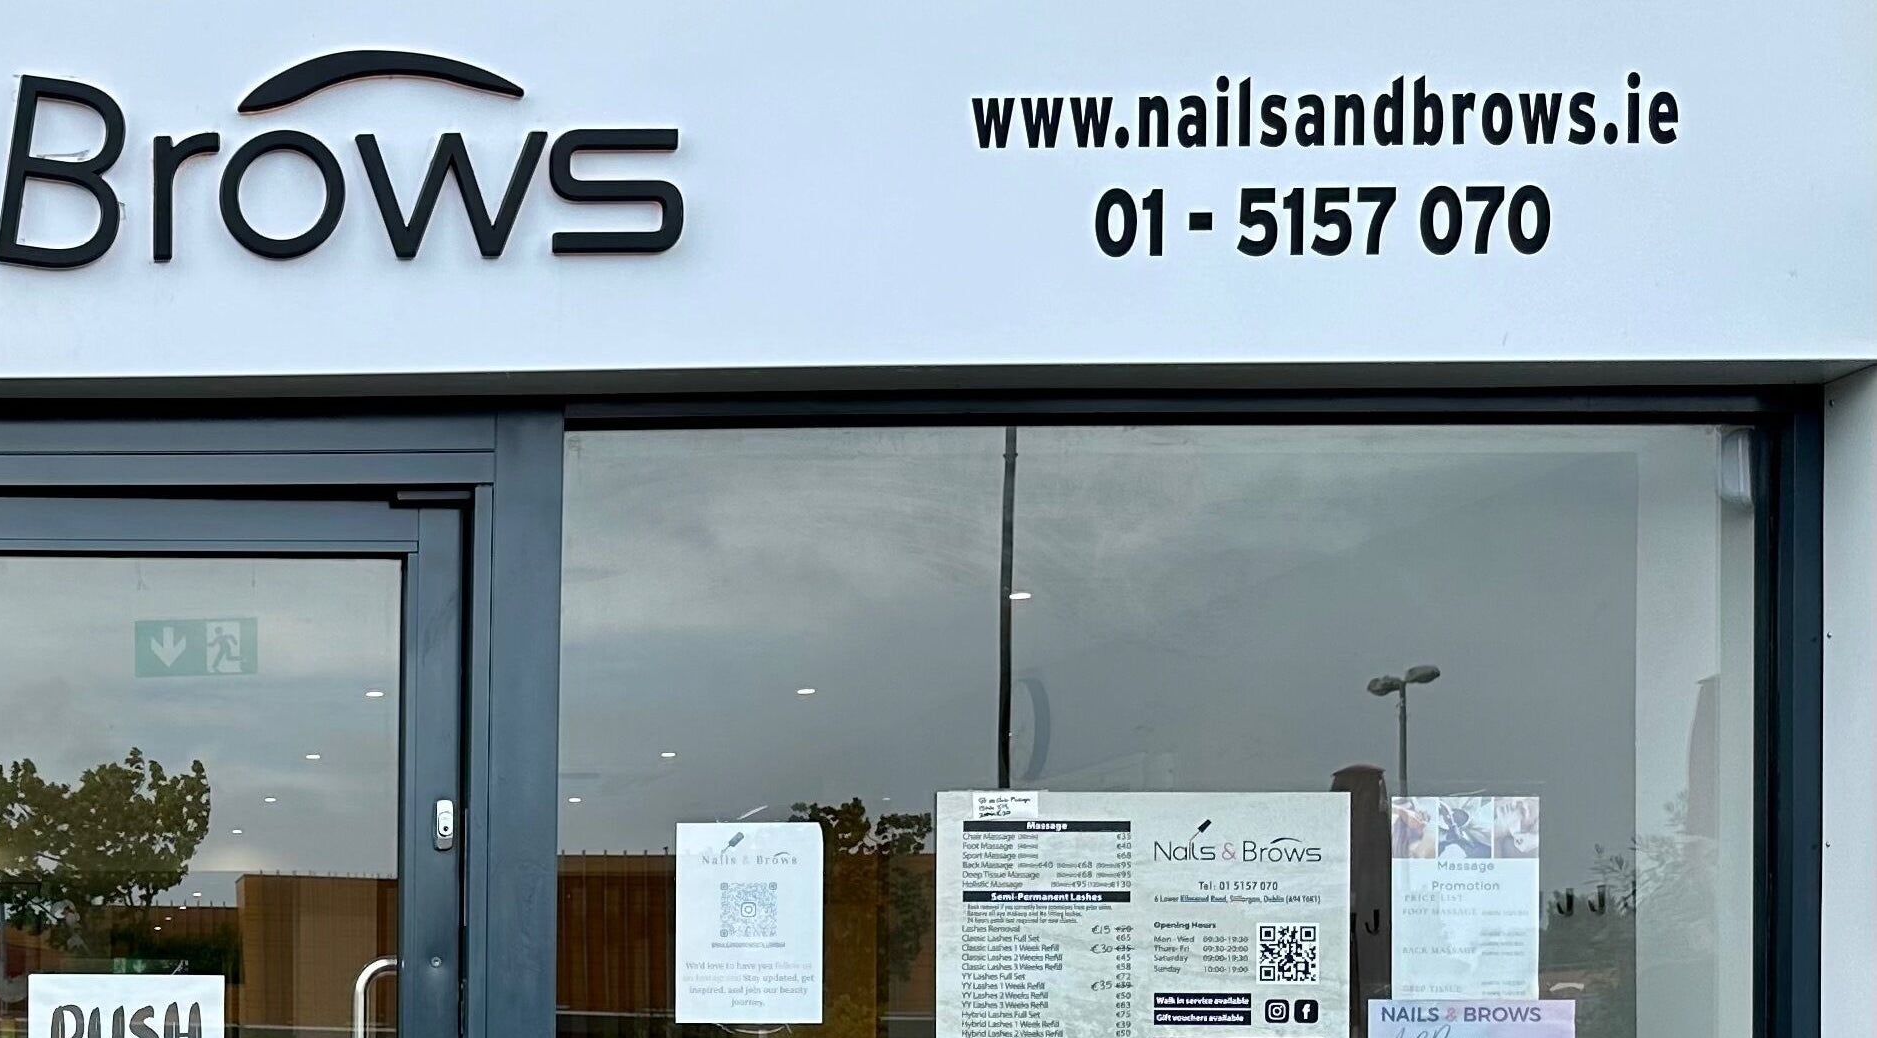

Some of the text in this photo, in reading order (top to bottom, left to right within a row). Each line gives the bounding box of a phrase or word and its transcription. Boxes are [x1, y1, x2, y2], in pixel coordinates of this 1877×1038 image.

[972, 72, 1679, 148] www.nailsandbrows.ie
[1095, 185, 1551, 257] 01 - 5157 070
[1027, 822, 1068, 831] Massage
[980, 843, 1013, 851] Massage
[1154, 841, 1321, 862] Nails & Brows
[702, 855, 736, 865] Nails
[756, 852, 798, 865] Brows
[963, 852, 982, 860] Sport
[984, 852, 1016, 860] Massage
[1437, 860, 1494, 873] Massage
[1219, 882, 1230, 890] 01
[1234, 882, 1257, 890] 5157
[1260, 882, 1278, 890] 070
[1432, 880, 1500, 892] Promotion
[991, 893, 1102, 901] Semi-Permanent Lashes
[1090, 944, 1113, 954] €30
[1154, 966, 1181, 974] Sunday
[1091, 980, 1112, 991] €35
[1214, 997, 1249, 1005] available
[1156, 1014, 1171, 1022] Gift
[1209, 1014, 1244, 1022] available
[1382, 1007, 1541, 1023] NAILS & BROWS
